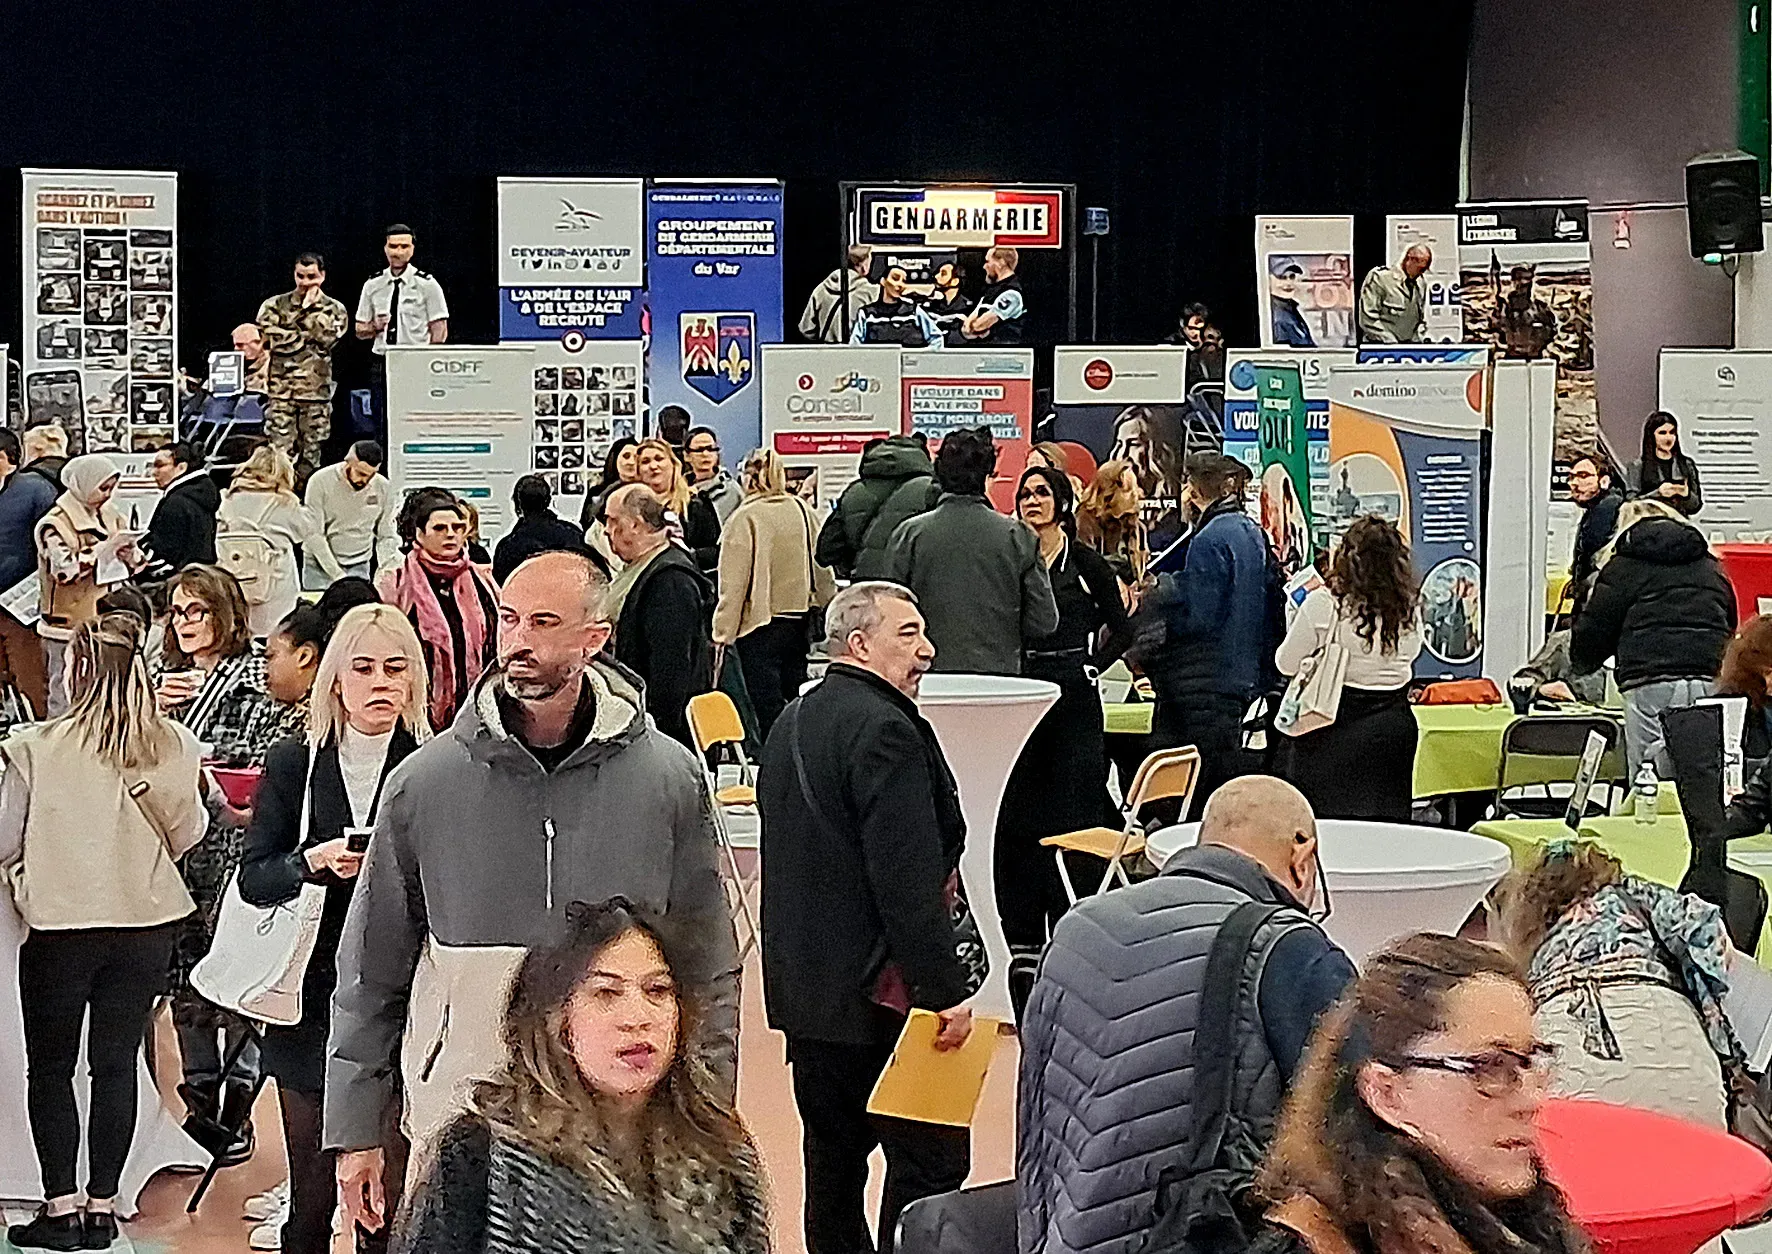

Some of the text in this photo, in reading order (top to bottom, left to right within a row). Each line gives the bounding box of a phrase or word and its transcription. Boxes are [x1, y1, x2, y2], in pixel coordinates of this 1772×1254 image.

[876, 206, 1043, 231] GENDARMERIE
[658, 221, 775, 231] GROUPEMENT
[658, 233, 677, 242] DE
[695, 263, 740, 274] du Var
[574, 290, 594, 301] DE
[597, 290, 632, 301] L'AIR
[534, 303, 554, 313] DE
[557, 303, 622, 313] L'ESPACE
[539, 316, 604, 326] RECRUTE
[967, 387, 1000, 397] DANS
[1366, 379, 1417, 398] domino
[787, 394, 862, 414] Conseil
[955, 401, 979, 410] PRO
